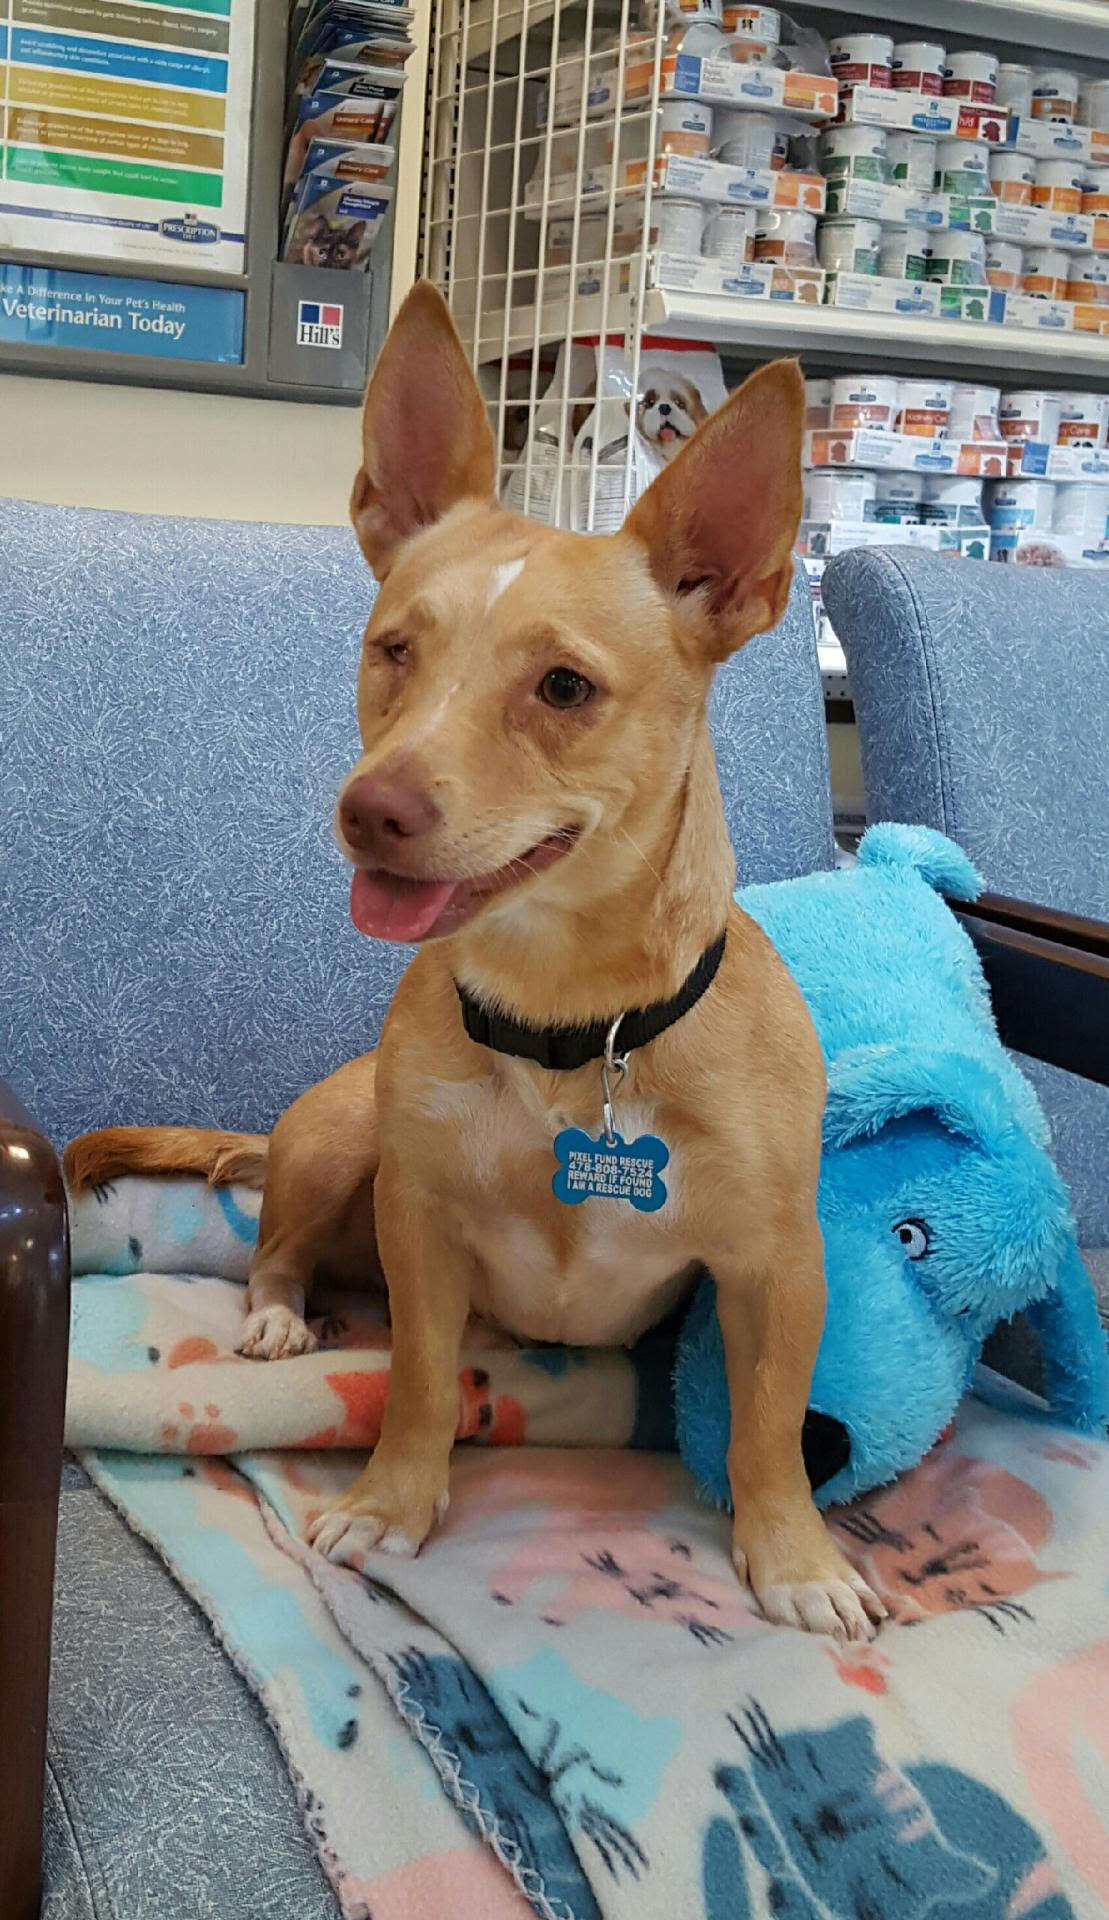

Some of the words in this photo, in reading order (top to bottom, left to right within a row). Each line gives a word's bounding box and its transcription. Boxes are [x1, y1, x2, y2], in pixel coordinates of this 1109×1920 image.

[162, 222, 216, 238] PRESCRIPTION
[17, 284, 24, 295] A
[28, 285, 82, 302] Difference
[86, 292, 95, 303] In
[99, 294, 123, 307] Your
[126, 298, 150, 310] Pet's
[152, 301, 186, 314] Health
[2, 298, 122, 329] Veterinarian
[128, 311, 186, 341] Today
[301, 325, 340, 345] Hill's
[569, 1151, 592, 1162] PIXEL
[594, 1153, 617, 1165] FUND
[620, 1157, 653, 1169] RESCUE
[568, 1161, 653, 1178] 478-808-7524
[568, 1170, 606, 1183] REWARD
[609, 1174, 618, 1184] IF
[620, 1176, 653, 1188] FOUND
[567, 1179, 571, 1190] I
[572, 1180, 586, 1190] AM
[588, 1181, 594, 1191] A
[596, 1183, 631, 1196] RESCUE
[633, 1186, 652, 1198] DOG
